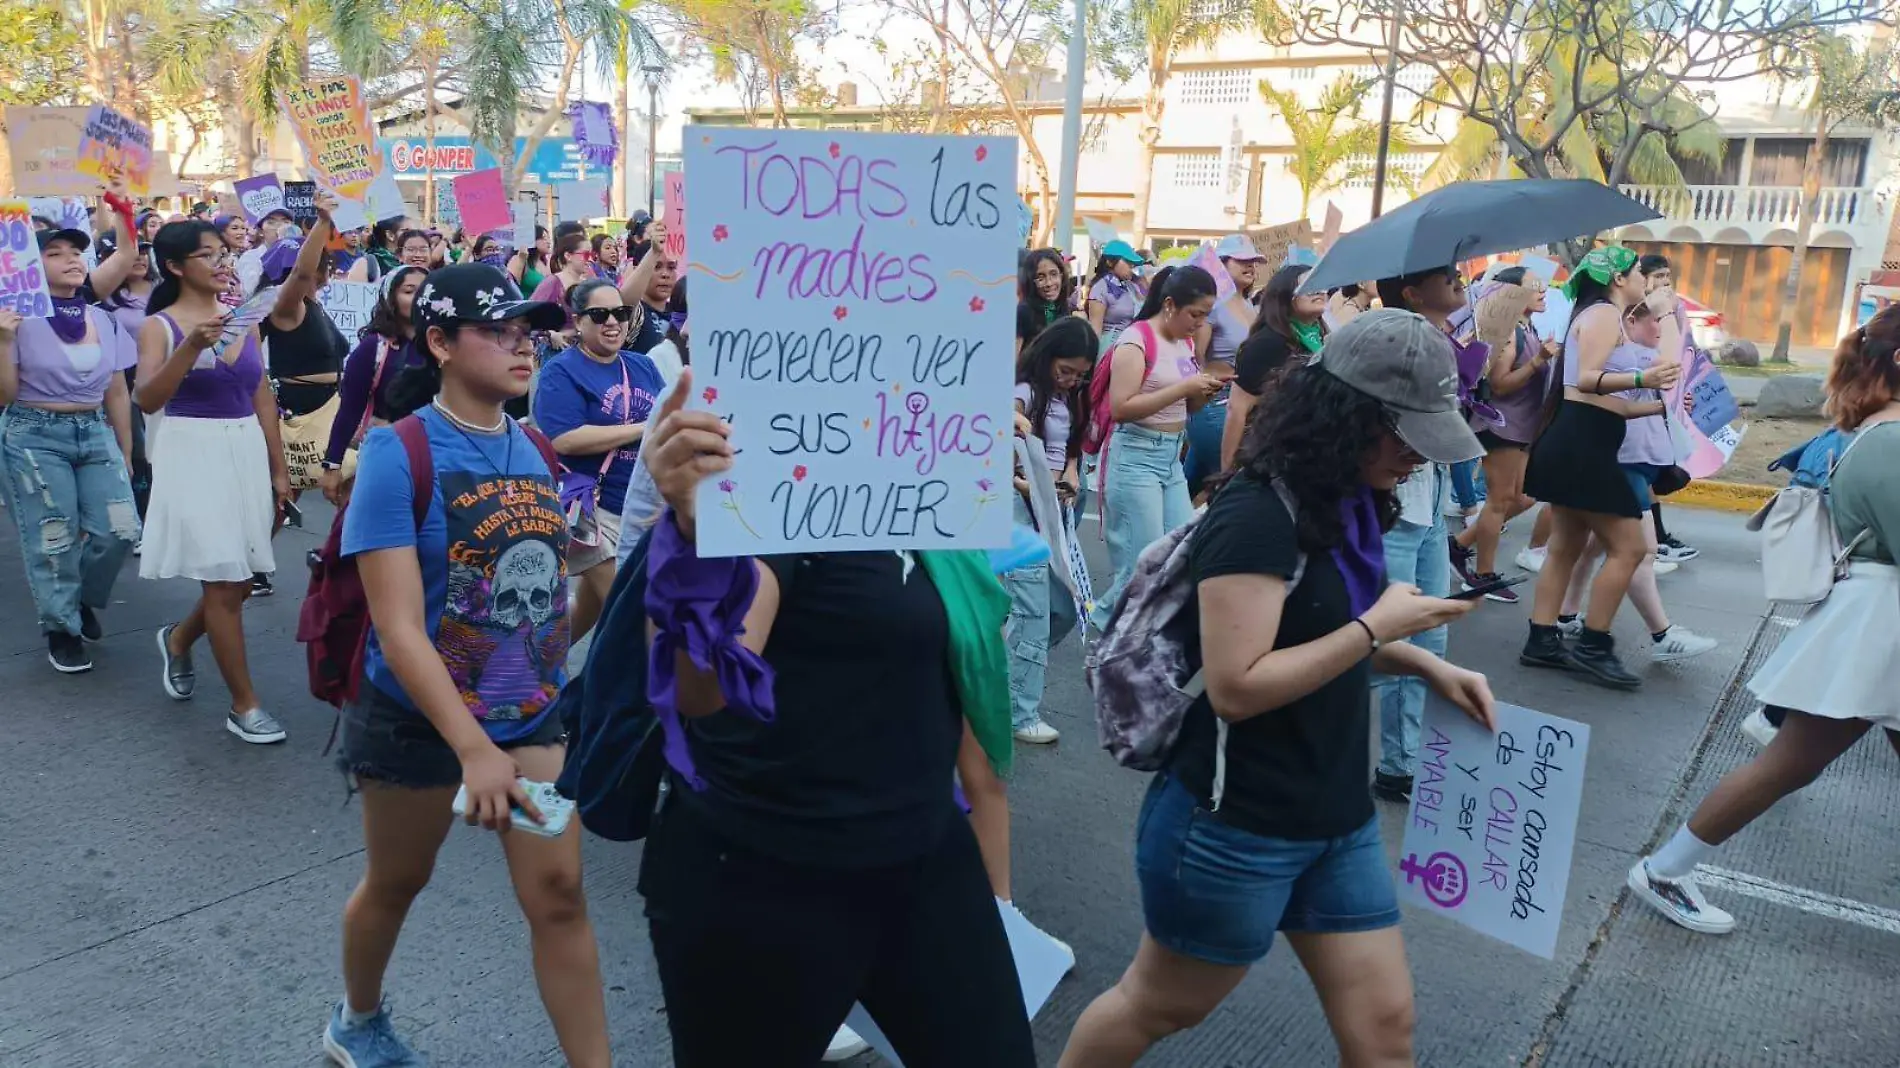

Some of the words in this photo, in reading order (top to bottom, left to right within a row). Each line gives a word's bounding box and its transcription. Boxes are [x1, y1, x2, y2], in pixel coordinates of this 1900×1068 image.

[295, 95, 351, 119] GRANDE
[320, 80, 347, 97] pone
[411, 145, 475, 170] GONPER
[715, 140, 908, 221] TODAS
[929, 146, 1001, 229] las
[753, 223, 939, 303] madres
[709, 327, 886, 383] merecen
[907, 333, 984, 387] ver
[287, 440, 316, 453] WANT
[769, 412, 851, 455] sus
[875, 390, 993, 475] hijas
[473, 509, 513, 540] HASTA
[510, 506, 528, 518] LA
[771, 480, 955, 540] VOLVER
[1496, 731, 1525, 765] de
[1518, 725, 1574, 799] Estoy
[1414, 726, 1452, 836] AMABLE
[1457, 794, 1477, 841] ser
[1479, 787, 1518, 891] CALLAR
[1510, 809, 1548, 920] cansada
